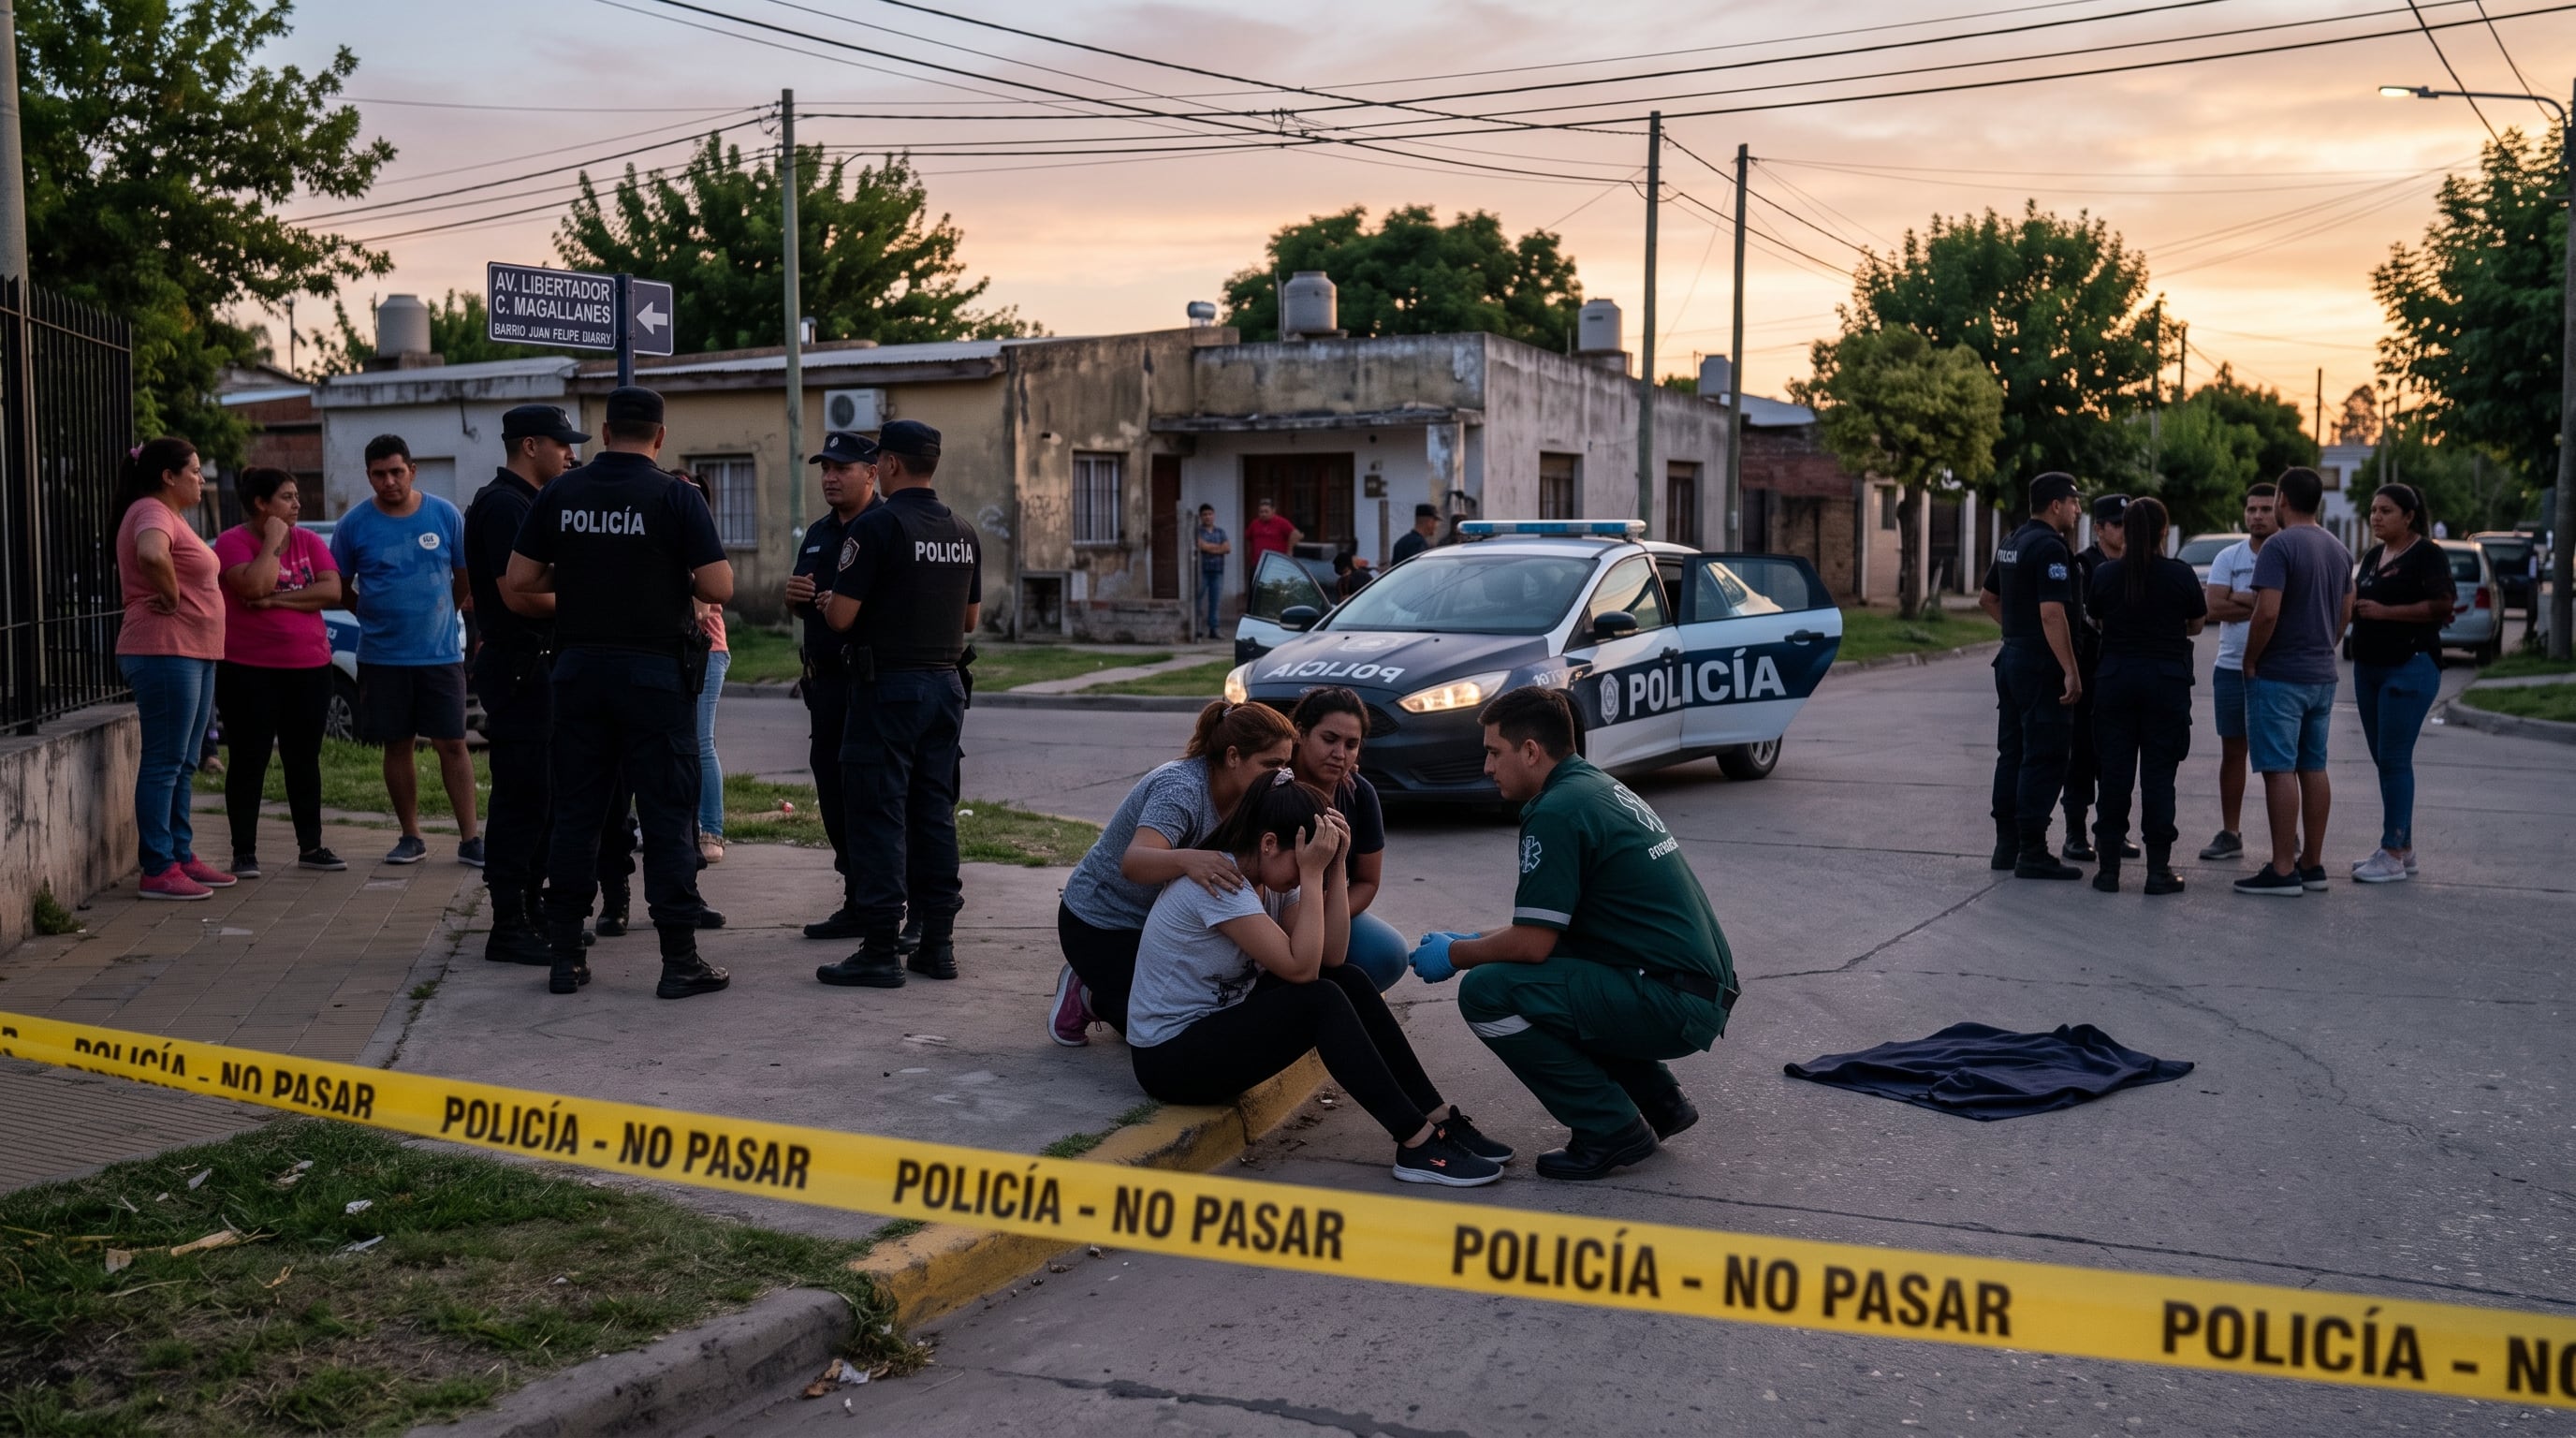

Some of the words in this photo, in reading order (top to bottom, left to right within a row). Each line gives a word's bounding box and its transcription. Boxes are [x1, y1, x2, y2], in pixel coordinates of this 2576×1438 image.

[495, 271, 518, 292] AV.
[521, 274, 610, 301] LIBERTADOR
[495, 295, 510, 315] C.
[515, 296, 611, 324] MAGALLANES
[494, 323, 526, 337] BARRIO
[529, 326, 550, 339] JUAN
[553, 328, 579, 342] FELIPE
[561, 506, 646, 536] POLICÍA
[915, 537, 974, 565] POLICÍA
[1629, 647, 1787, 717] POLICÍA
[220, 1061, 263, 1094] NO
[271, 1069, 375, 1121] PASAR
[440, 1095, 579, 1156] POLICÍA
[593, 1139, 607, 1151] -
[618, 1121, 674, 1170] NO
[682, 1130, 811, 1190] PASAR
[892, 1159, 1061, 1225] POLICÍA
[1078, 1205, 1096, 1217] -
[1111, 1185, 1176, 1240] NO
[1191, 1194, 1346, 1262] PASAR
[1452, 1224, 1661, 1299] POLICÍA
[1681, 1277, 1703, 1290] -
[1723, 1254, 1801, 1314] NO
[1821, 1265, 2013, 1339] PASAR
[2162, 1299, 2428, 1383] POLICÍA
[2452, 1359, 2480, 1374] -
